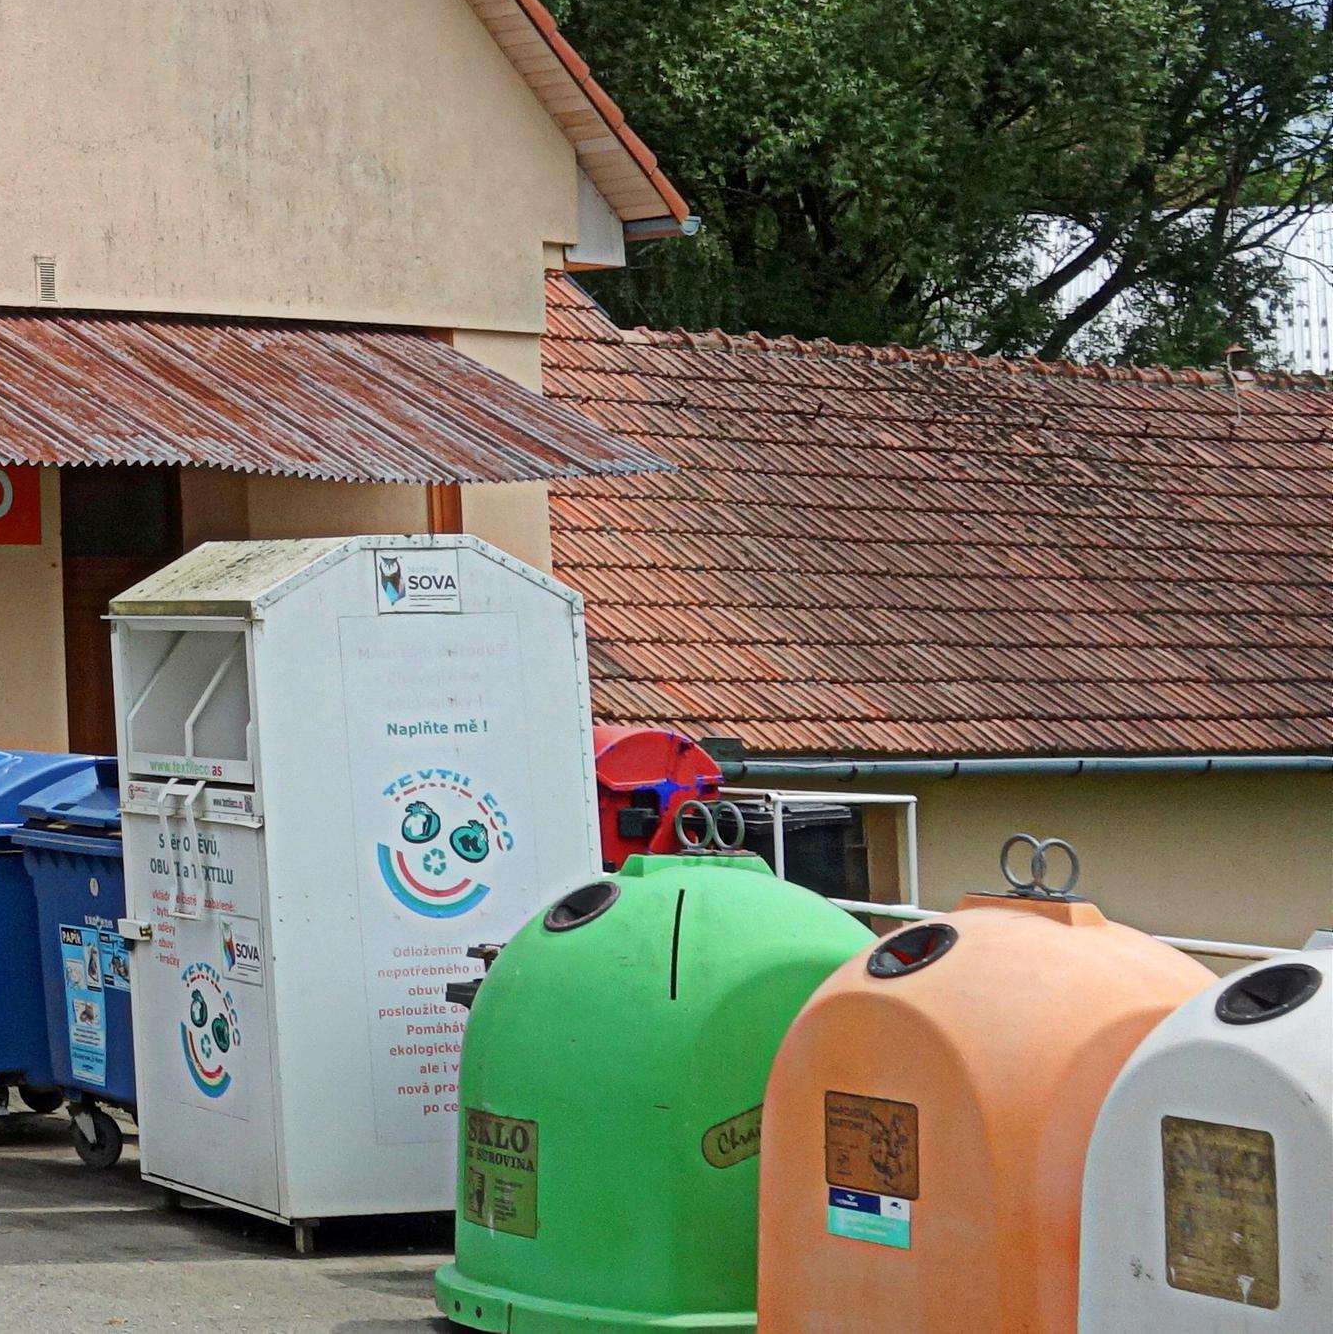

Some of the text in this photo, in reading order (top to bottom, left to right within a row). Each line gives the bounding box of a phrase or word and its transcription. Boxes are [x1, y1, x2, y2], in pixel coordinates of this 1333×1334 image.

[408, 575, 457, 591] SOVA
[387, 719, 488, 738] Naplňte mě !
[158, 832, 181, 851] Sěr
[235, 942, 260, 962] SOVA
[393, 944, 462, 958] Odložením
[378, 963, 469, 980] nepotřebného
[420, 1062, 439, 1074] ale
[398, 1082, 430, 1095] nová
[423, 1104, 439, 1116] po
[468, 1114, 530, 1153] SKLO
